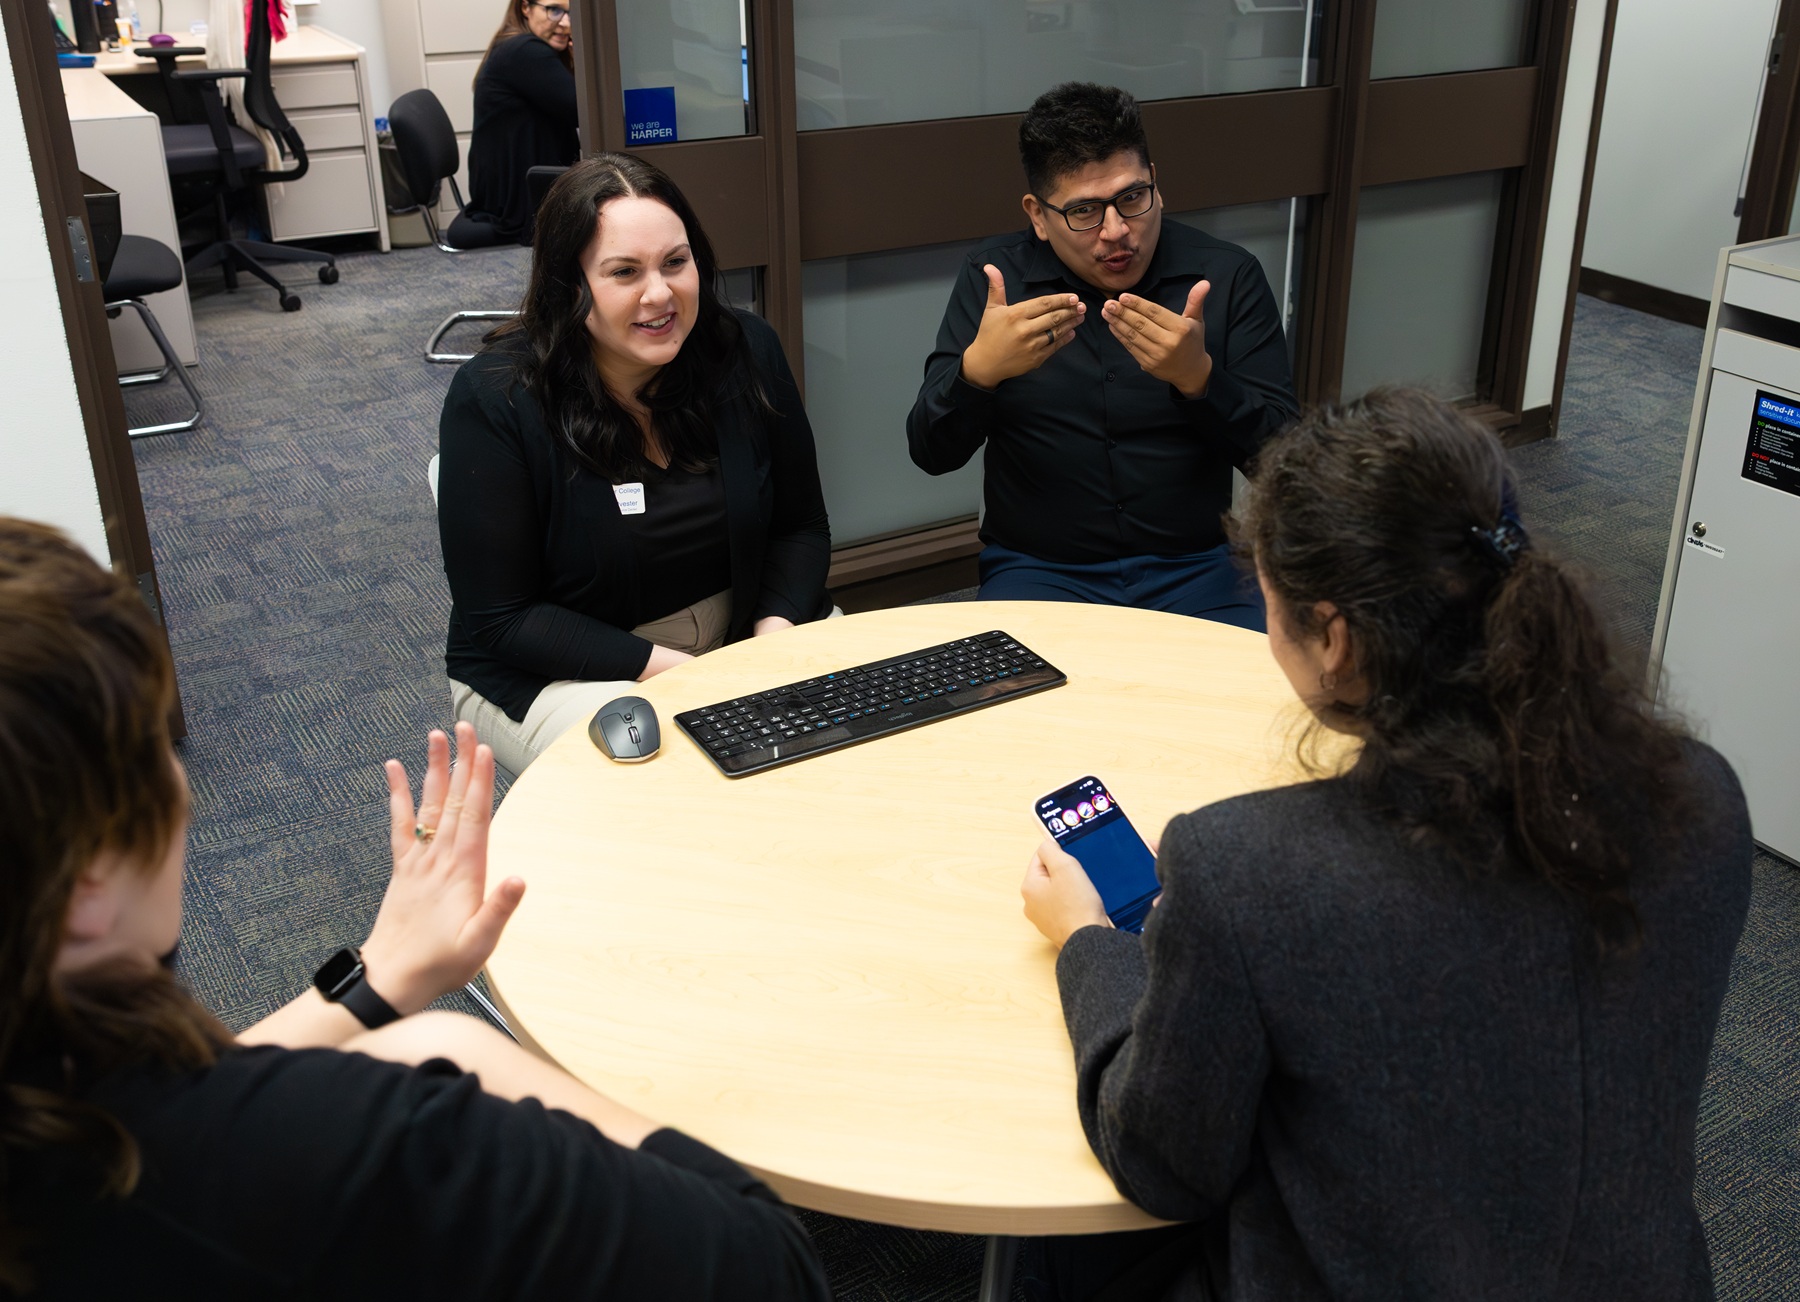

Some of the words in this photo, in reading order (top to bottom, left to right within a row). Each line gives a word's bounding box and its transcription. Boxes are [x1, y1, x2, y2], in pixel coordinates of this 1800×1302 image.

[630, 122, 645, 130] we
[646, 121, 660, 129] are
[631, 128, 673, 139] HARPER
[1761, 400, 1794, 417] Shred-it
